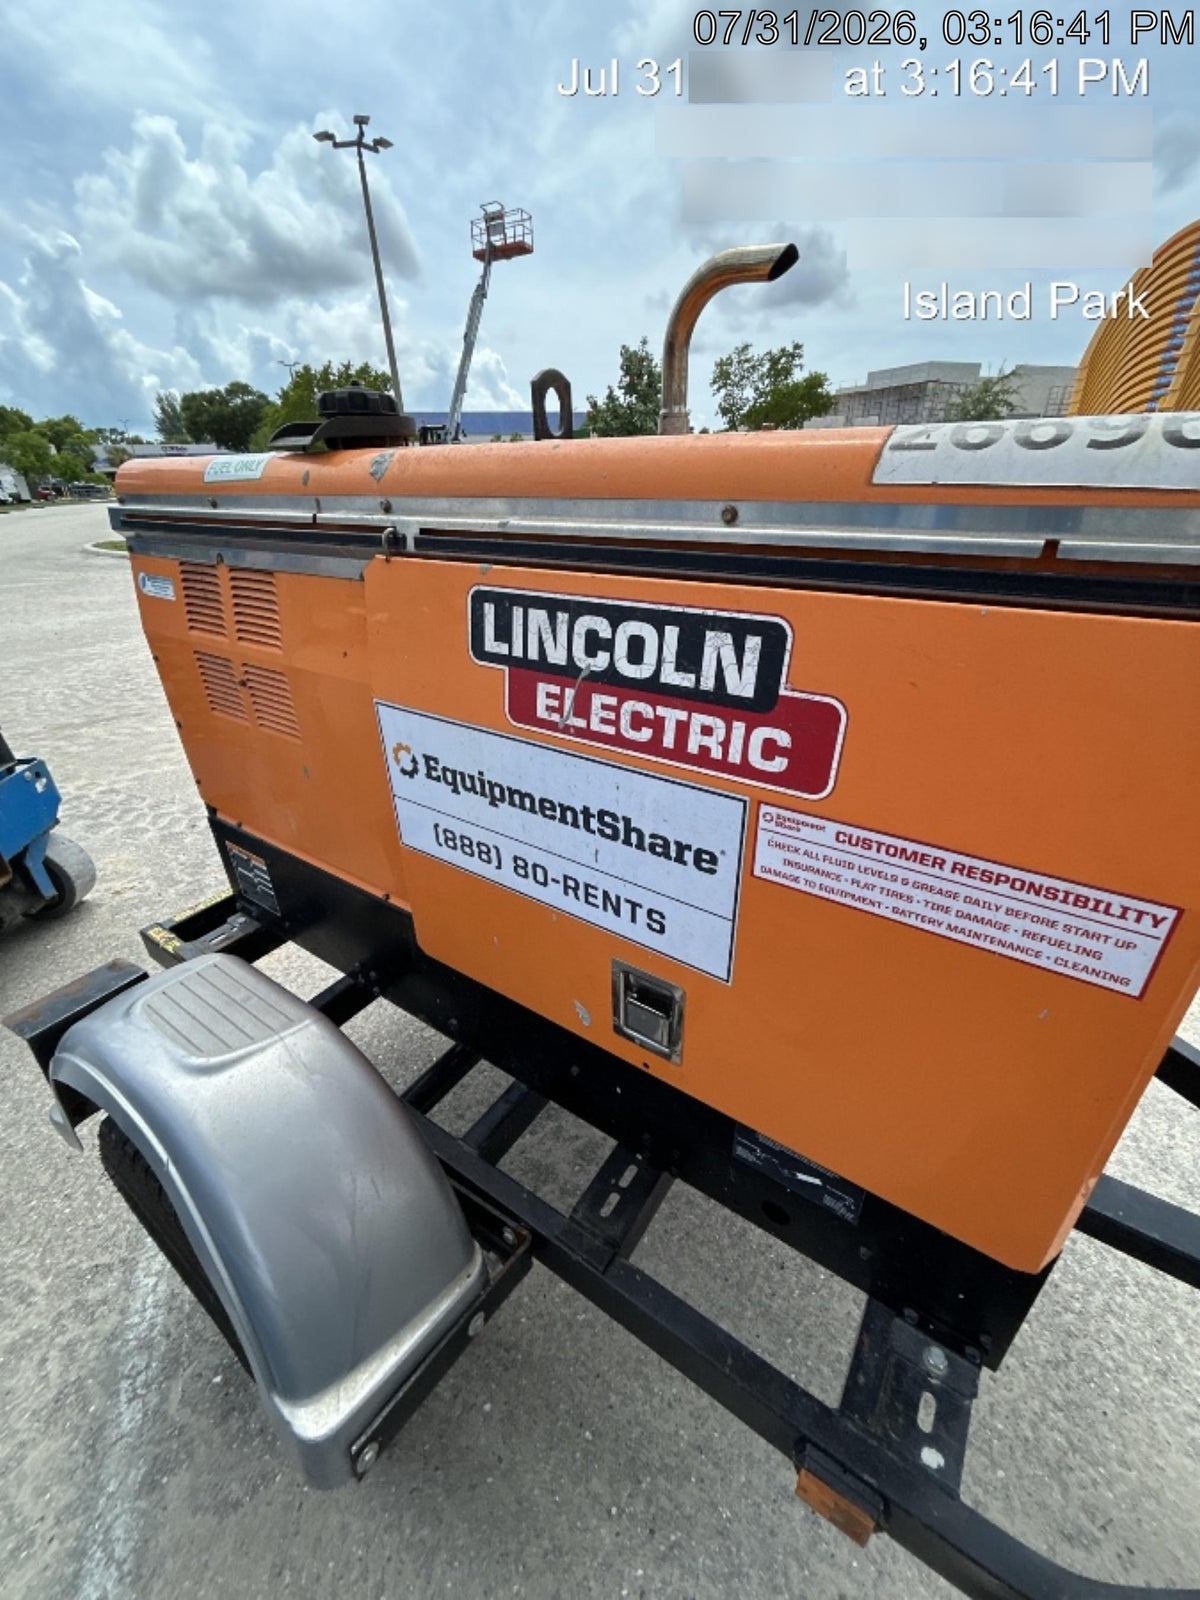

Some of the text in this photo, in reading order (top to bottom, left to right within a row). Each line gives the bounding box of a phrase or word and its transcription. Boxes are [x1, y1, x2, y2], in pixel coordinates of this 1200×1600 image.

[482, 602, 763, 698] LINCOLN
[536, 682, 792, 773] ELECTRIC
[423, 753, 719, 876] EquipmentShare
[433, 822, 667, 936] (888) 80-RENTS
[760, 865, 1132, 987] DAMAGE TO EQUIPMENT BATTERY MAINTENANCE CLEANING
[767, 839, 801, 855] CHECK
[803, 849, 820, 861] ALL
[822, 854, 854, 870] FLUID
[857, 863, 898, 883] LEVELS
[911, 881, 960, 901] GREASE
[963, 895, 1003, 913] DAILY
[1004, 906, 1059, 930] BEFORE
[1062, 923, 1110, 945] START
[1113, 938, 1138, 951] UP
[782, 858, 842, 882] INSURANCE
[879, 886, 914, 904] TIRES
[923, 899, 952, 916] TIRE
[955, 909, 1011, 934] DAMAGE
[1021, 929, 1104, 961] REFUELING
[835, 830, 1169, 929] CUSTOMER RESPONSIBILITY
